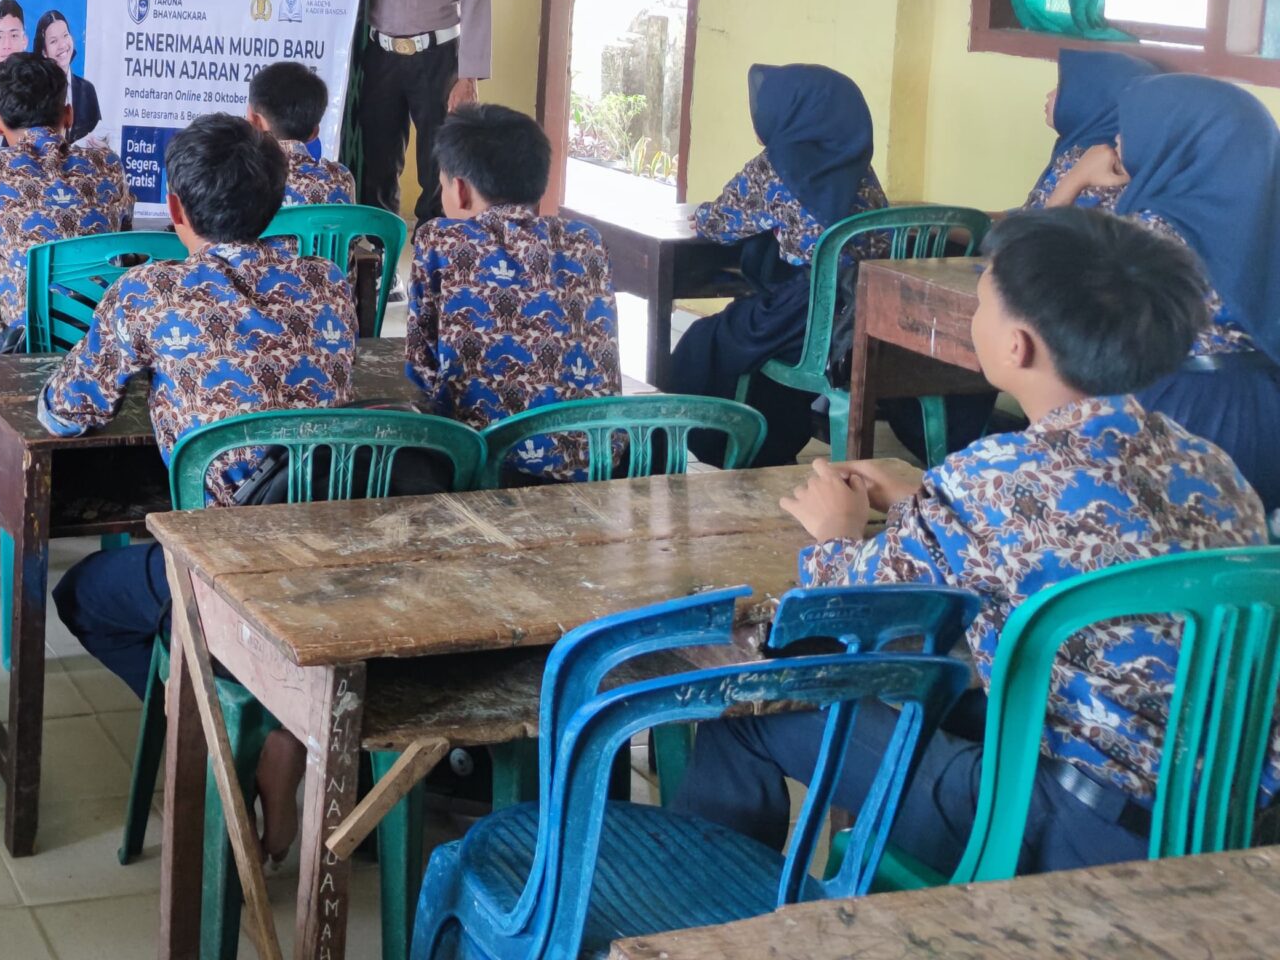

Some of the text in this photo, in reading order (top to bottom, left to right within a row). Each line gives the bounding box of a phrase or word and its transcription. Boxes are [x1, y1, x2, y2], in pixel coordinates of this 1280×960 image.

[153, 10, 207, 21] BHAYANGKARA
[125, 32, 325, 60] PENERIMAAN MURID BARU
[125, 57, 176, 79] TAHUN
[179, 60, 240, 82] AJARAN
[124, 87, 247, 104] Pendaftaran Online 28 Oktober
[123, 108, 140, 119] SMA
[141, 109, 178, 121] Berasrama
[179, 111, 186, 121] &
[126, 139, 156, 154] Daftar
[125, 157, 161, 174] Segera,
[126, 173, 156, 188] Gratis!
